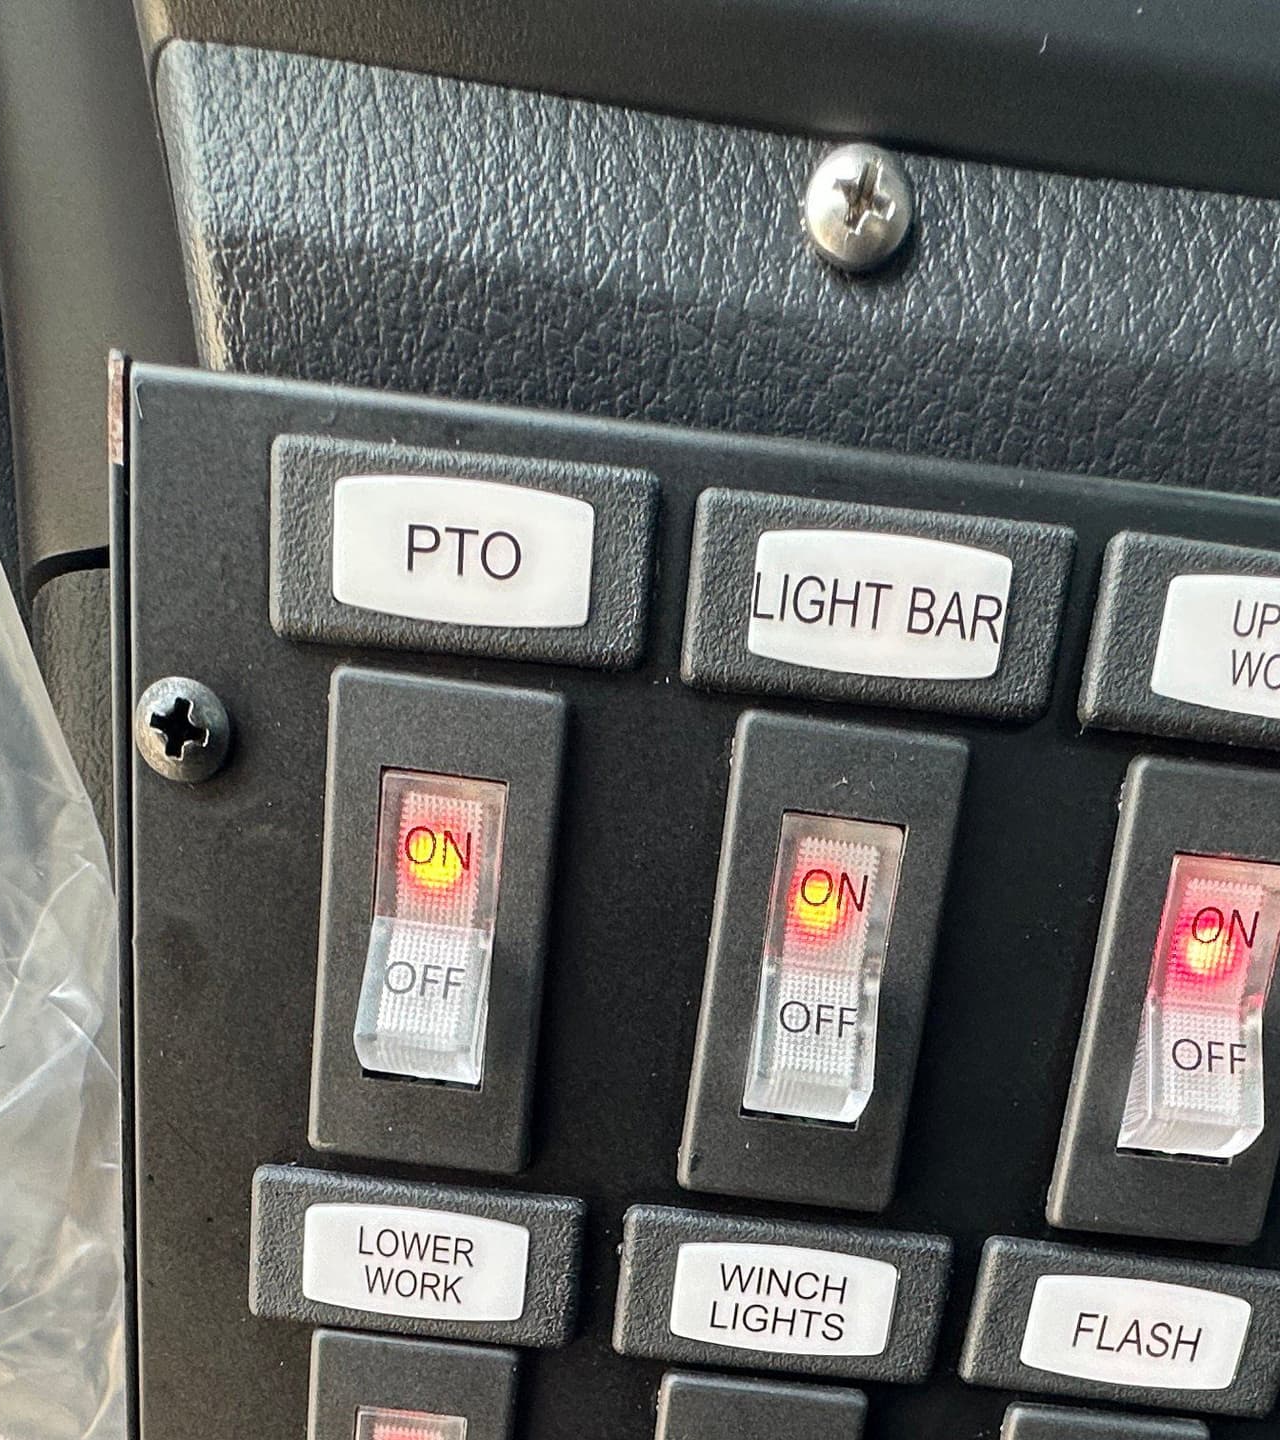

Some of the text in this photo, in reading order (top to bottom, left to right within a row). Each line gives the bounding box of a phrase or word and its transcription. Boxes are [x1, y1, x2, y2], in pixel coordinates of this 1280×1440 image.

[406, 524, 522, 581] PTO
[751, 572, 1003, 645] LIGHT BAR
[404, 826, 471, 870] ON
[800, 869, 867, 912] ON
[1191, 907, 1259, 949] ON
[385, 961, 464, 1000] OFF
[779, 999, 858, 1040] OFF
[1171, 1037, 1248, 1077] OFF
[357, 1226, 475, 1269] LOWER
[364, 1262, 464, 1304] WORK
[718, 1263, 847, 1305] WINCH
[710, 1300, 845, 1343] LIGHTS
[1072, 1312, 1201, 1362] FLASH
